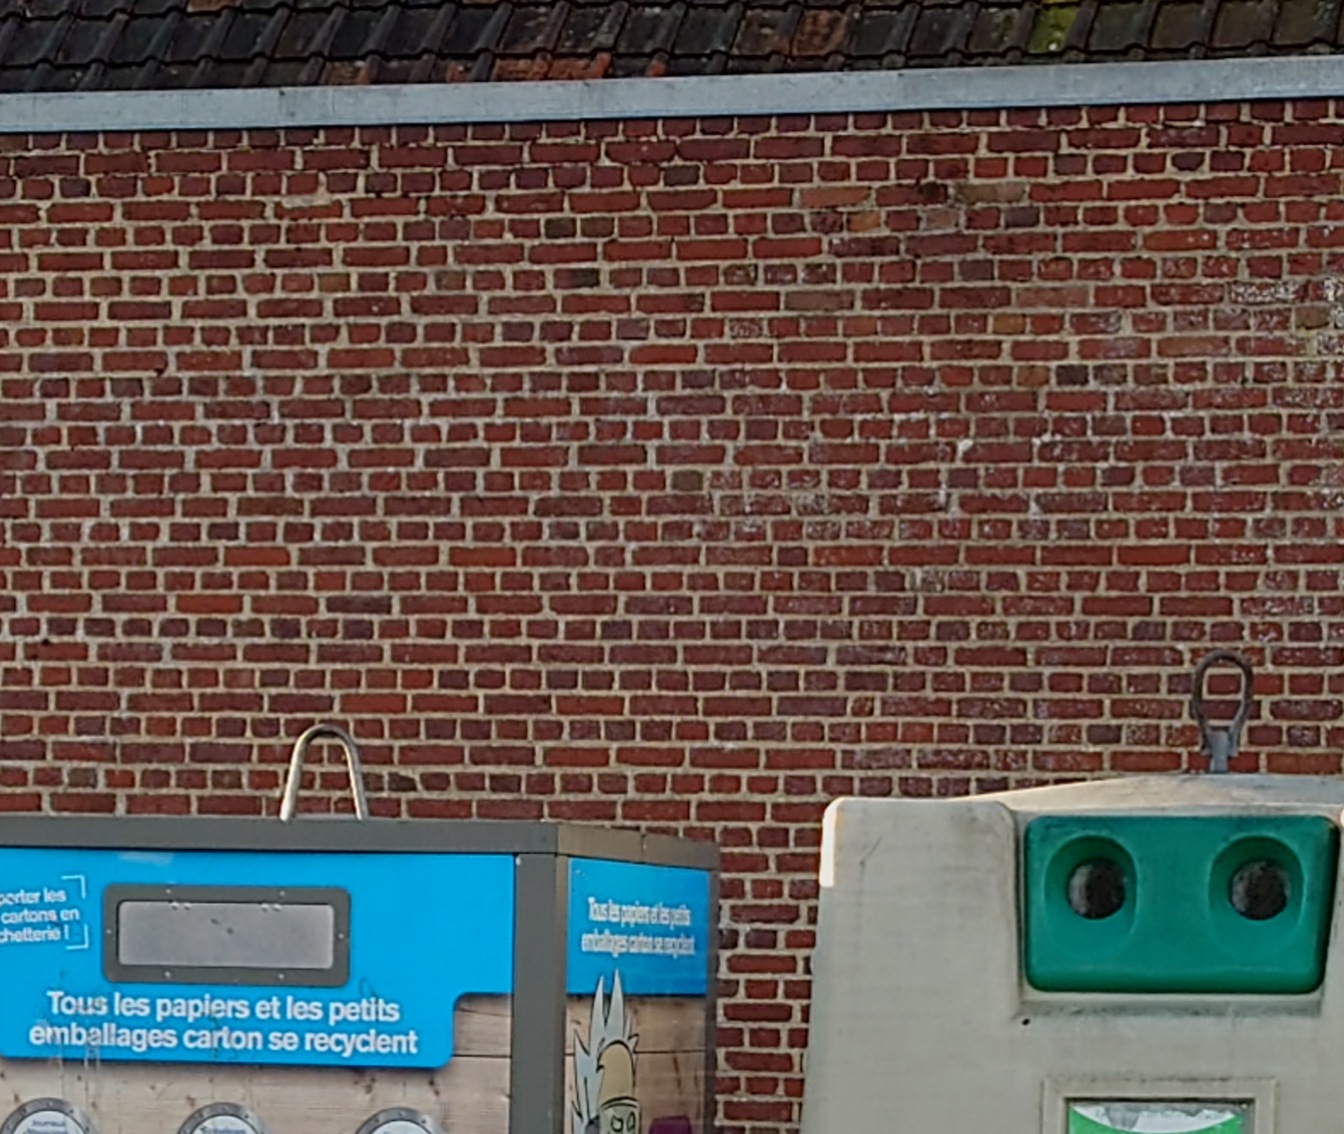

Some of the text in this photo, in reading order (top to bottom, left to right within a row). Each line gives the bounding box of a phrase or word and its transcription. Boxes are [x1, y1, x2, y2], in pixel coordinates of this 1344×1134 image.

[43, 887, 67, 903] les
[1, 907, 58, 925] cartons
[60, 908, 80, 921] en
[588, 896, 608, 921] Tous
[46, 990, 400, 1027] Tous les papiers et les petits
[29, 1021, 418, 1057] emballages carton se recyclent
